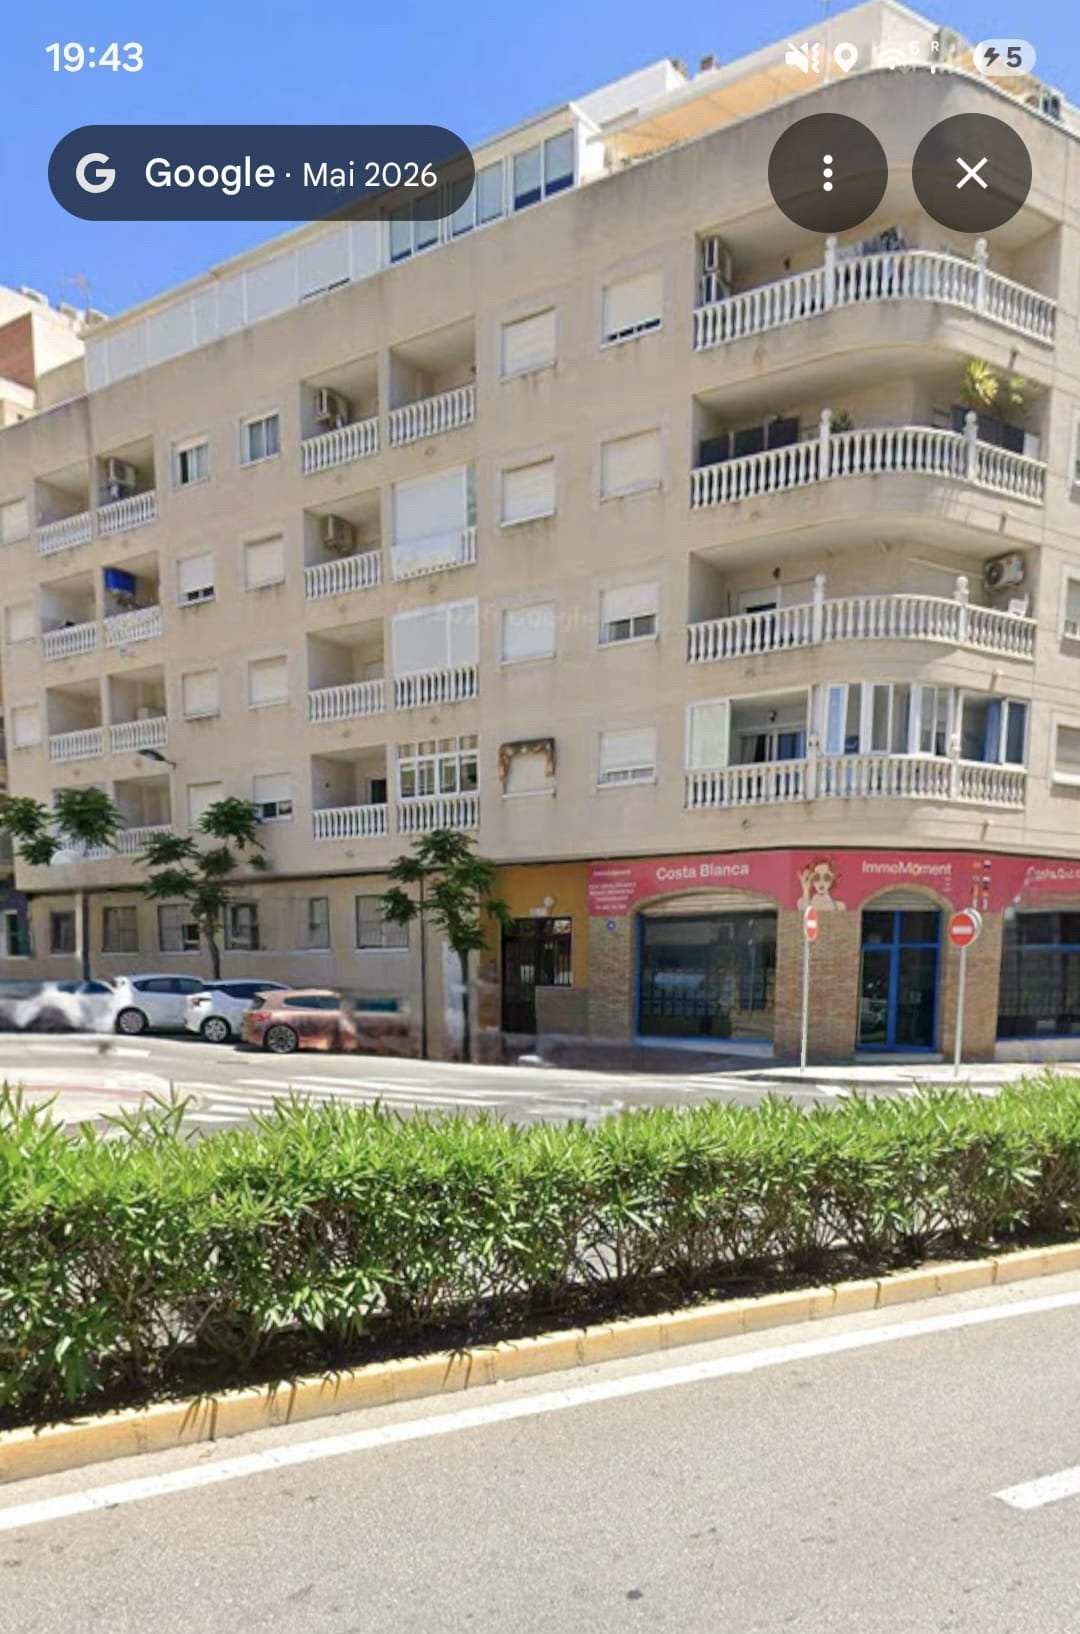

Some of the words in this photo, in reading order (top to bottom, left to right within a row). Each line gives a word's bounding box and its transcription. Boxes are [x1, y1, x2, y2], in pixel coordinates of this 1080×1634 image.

[656, 866, 697, 881] Costa
[700, 863, 750, 878] Blanca
[862, 860, 952, 876] ImmoMoment
